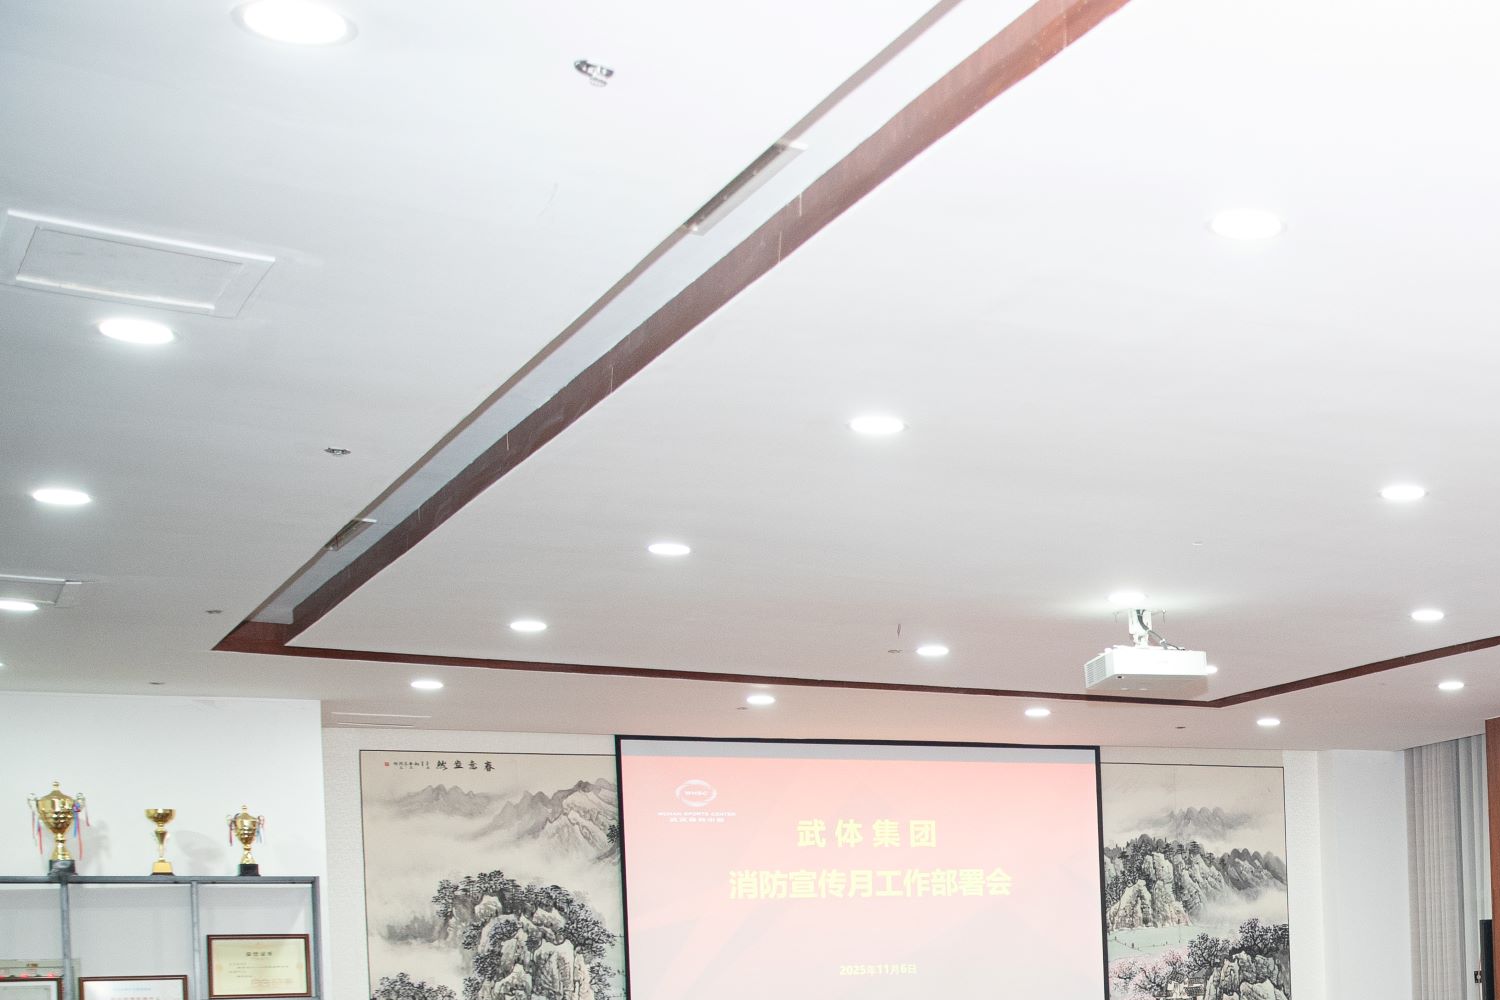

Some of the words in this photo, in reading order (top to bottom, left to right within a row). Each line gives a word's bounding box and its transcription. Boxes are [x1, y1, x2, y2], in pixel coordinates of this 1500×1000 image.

[796, 819, 938, 849] 武体集团
[729, 867, 1013, 900] 消防宣传月工作部署会
